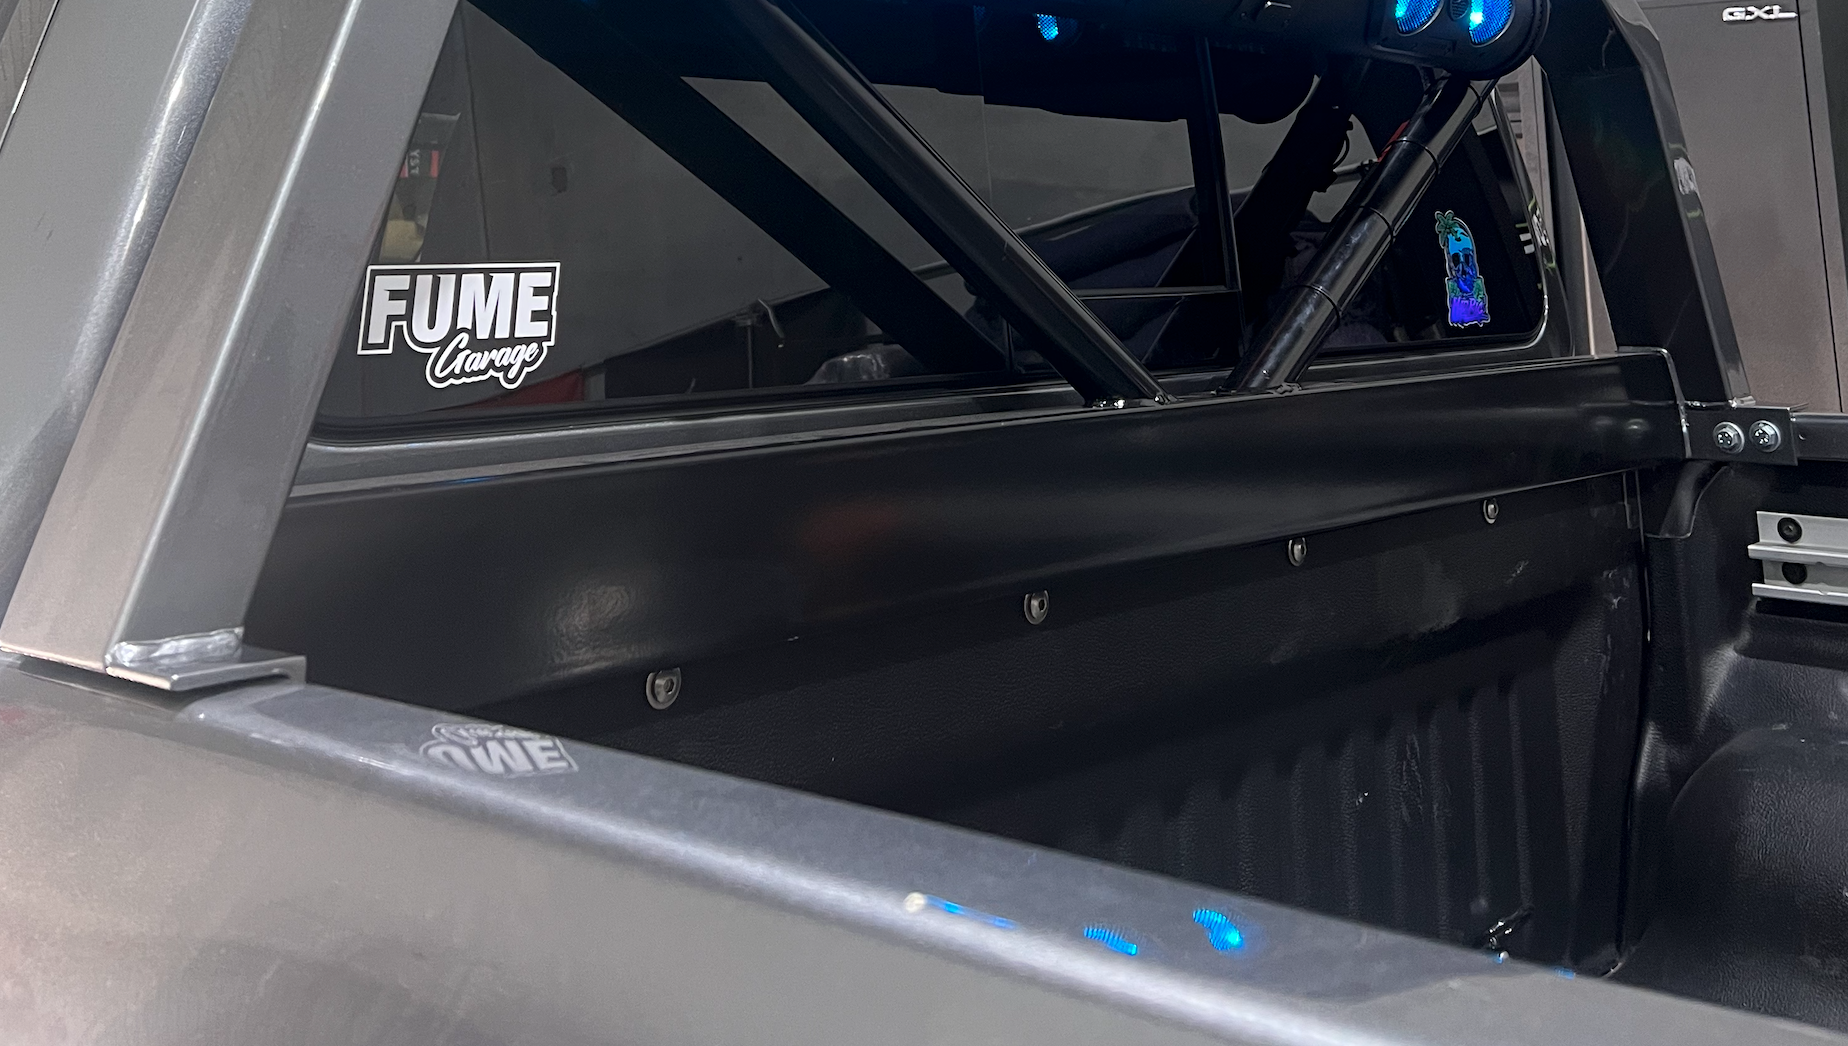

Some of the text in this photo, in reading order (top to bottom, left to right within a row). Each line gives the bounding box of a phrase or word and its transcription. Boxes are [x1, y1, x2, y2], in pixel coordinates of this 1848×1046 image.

[1722, 5, 1798, 21] GXL
[367, 272, 552, 343] FUME
[434, 332, 539, 379] Garage
